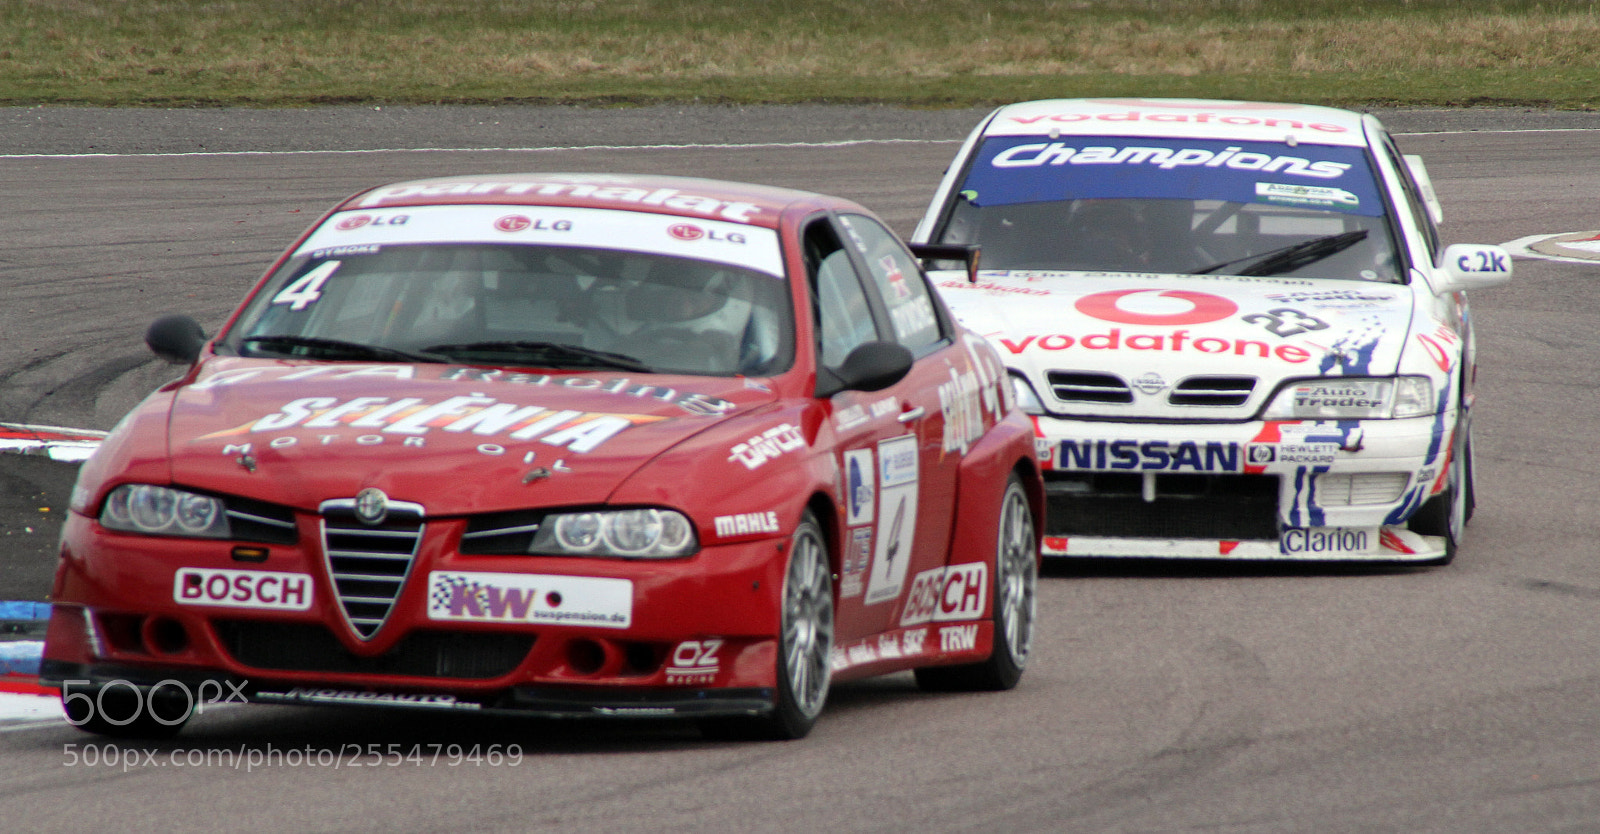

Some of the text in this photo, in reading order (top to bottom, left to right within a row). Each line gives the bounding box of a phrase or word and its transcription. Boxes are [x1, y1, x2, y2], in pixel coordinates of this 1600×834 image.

[1008, 111, 1348, 133] vodafone
[990, 141, 1352, 179] Champions
[361, 180, 762, 223] parmalat
[371, 214, 410, 227] LG
[533, 218, 574, 232] LG
[707, 229, 747, 245] LG
[1457, 251, 1508, 273] c.2k
[271, 260, 341, 311] 4
[1241, 307, 1330, 338] 23
[999, 328, 1311, 363] vodafone
[1296, 396, 1383, 409] Trader
[1311, 387, 1367, 397] Auto
[221, 434, 573, 473] MOTOR OIL
[1058, 438, 1239, 472] NISSAN
[1280, 455, 1335, 463] PACKARD
[713, 511, 780, 538] MAHLE
[1282, 527, 1368, 553] Clarion
[181, 572, 306, 605] BOSCH
[449, 584, 536, 619] KW
[904, 569, 983, 619] BOSCH
[533, 608, 627, 624] suspension.de
[938, 624, 979, 652] TRW
[673, 639, 724, 667] OZ
